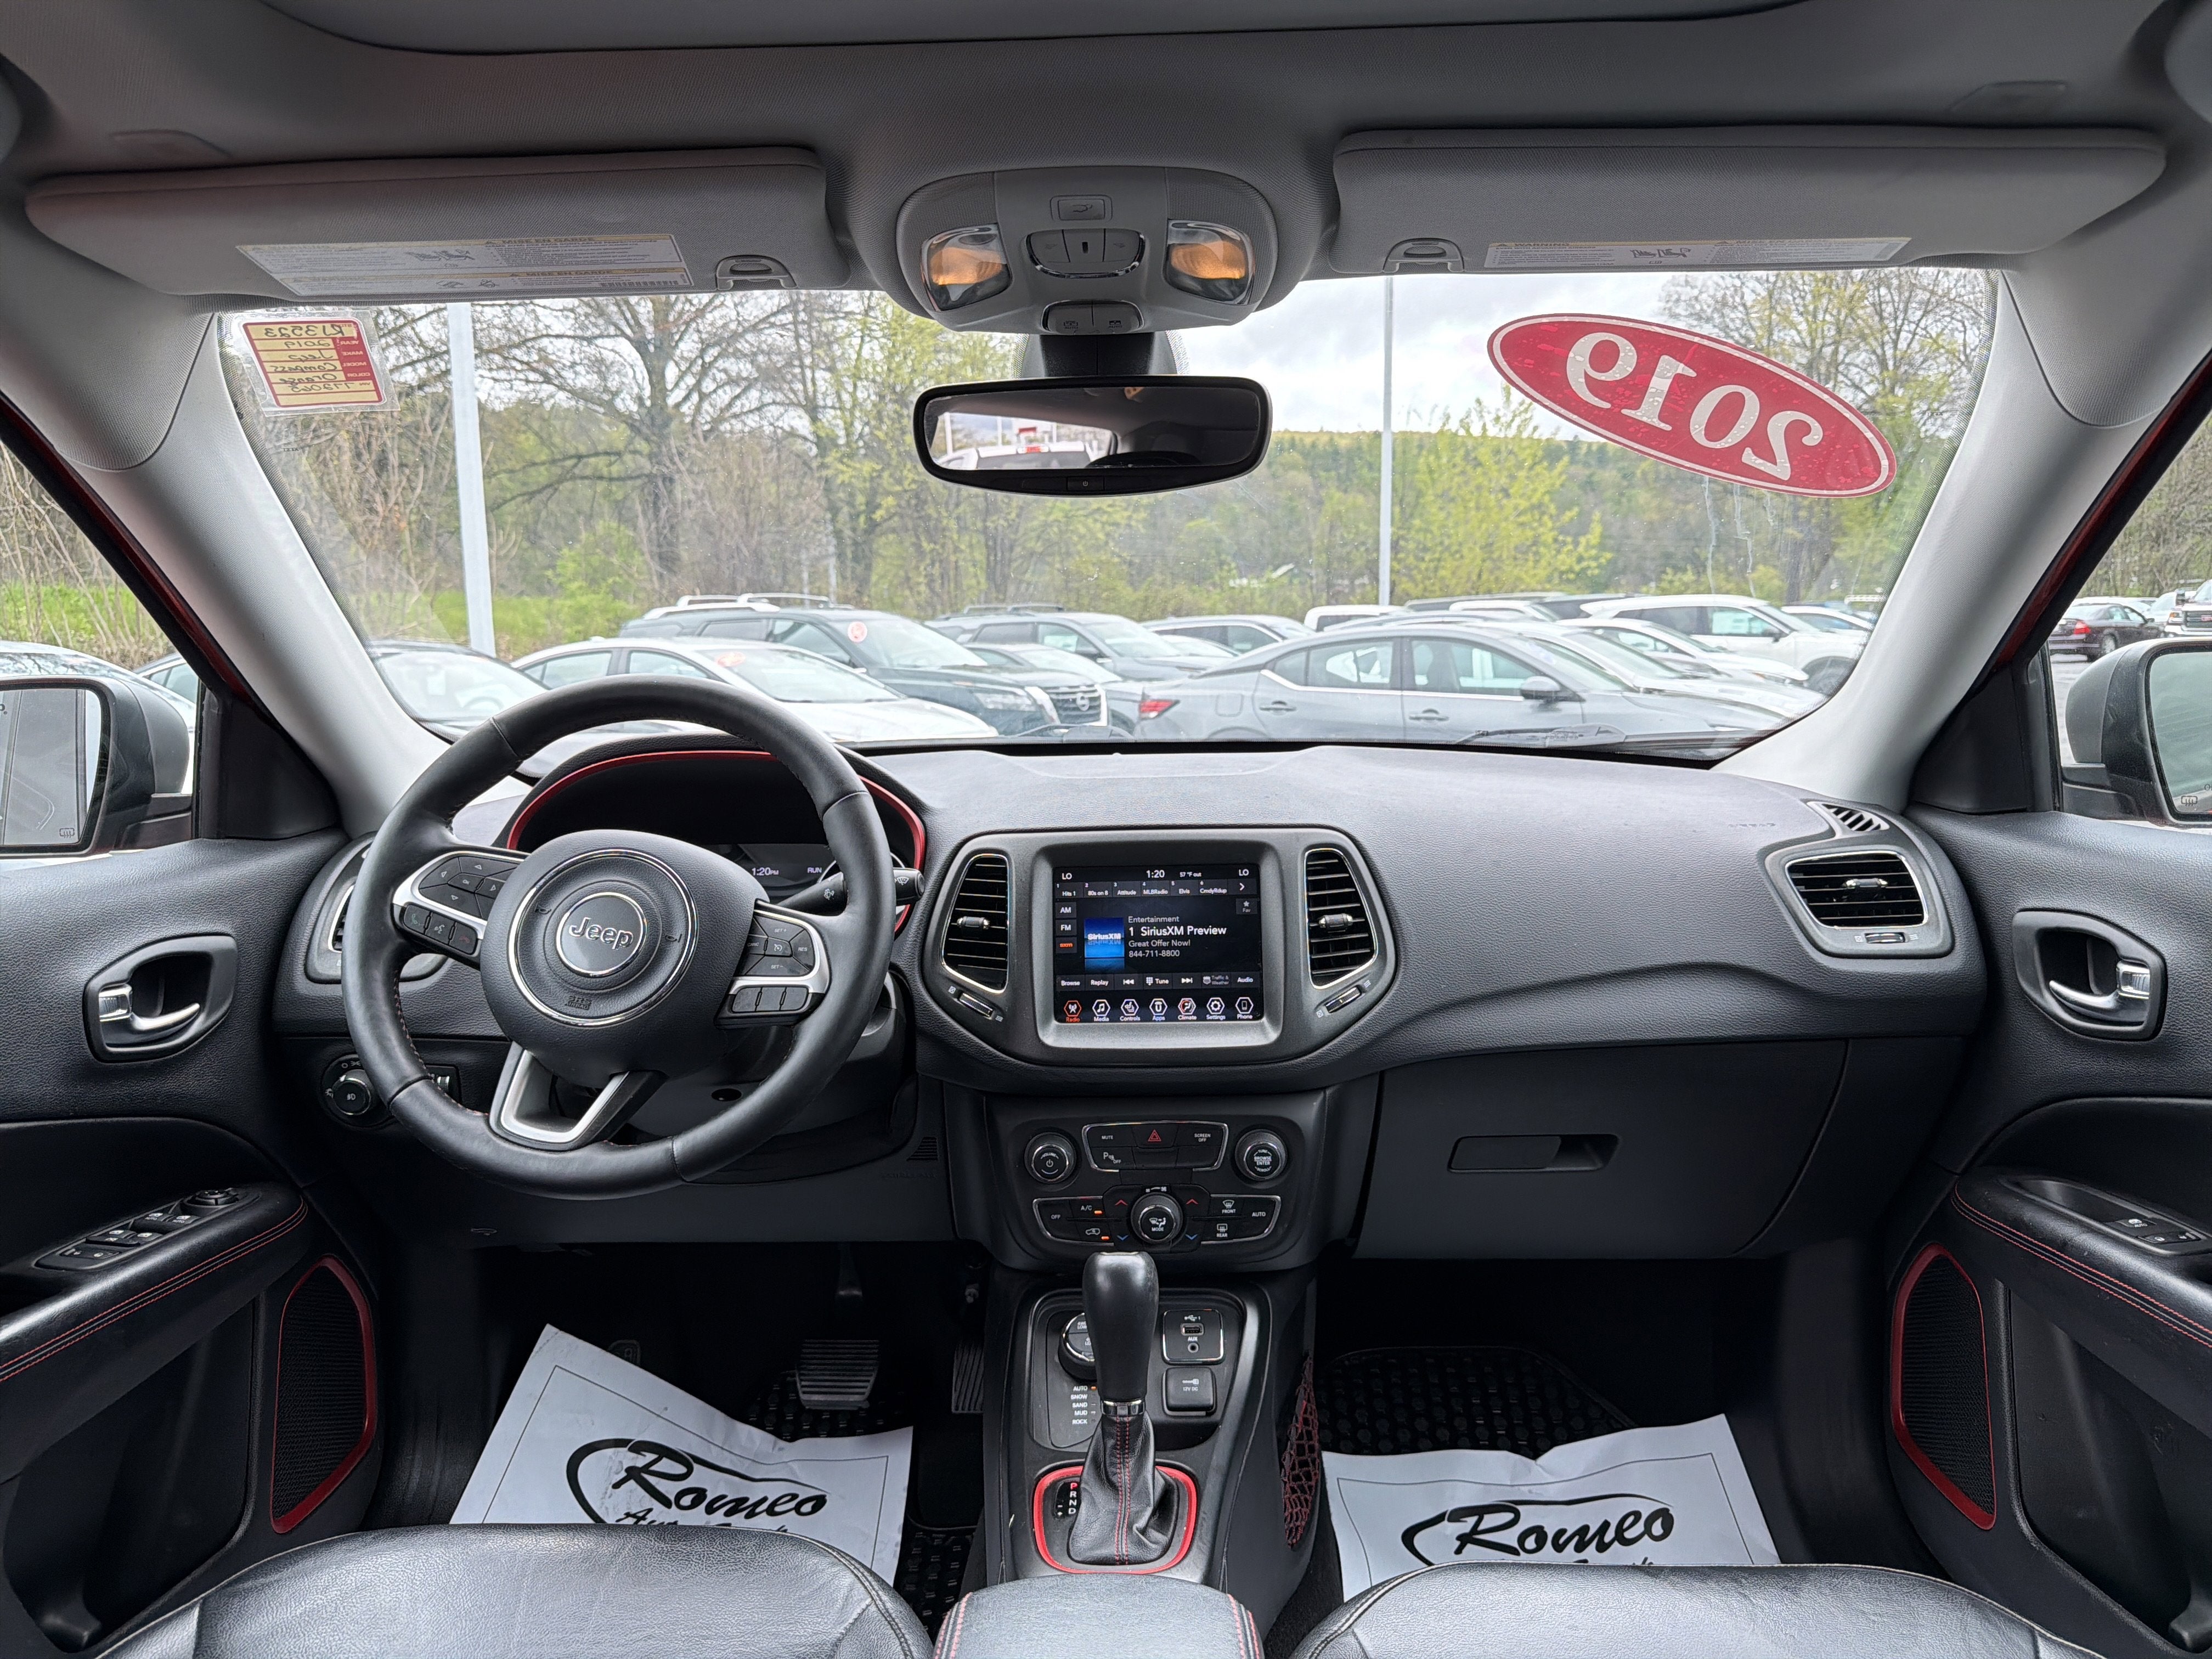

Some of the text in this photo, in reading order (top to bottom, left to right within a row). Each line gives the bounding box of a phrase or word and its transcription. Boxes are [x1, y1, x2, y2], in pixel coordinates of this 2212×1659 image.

[1146, 870, 1165, 878] 1:20
[569, 917, 634, 950] Jeep
[1129, 926, 1227, 936] 1 SiriusXM Preview
[1172, 939, 1190, 947] Now!
[1128, 950, 1180, 958] 844-711-8800
[568, 995, 592, 1005] SRS
[565, 1001, 592, 1011] AIRBAG
[612, 1438, 828, 1520] Romeo
[1447, 1502, 1674, 1557] Romeo
